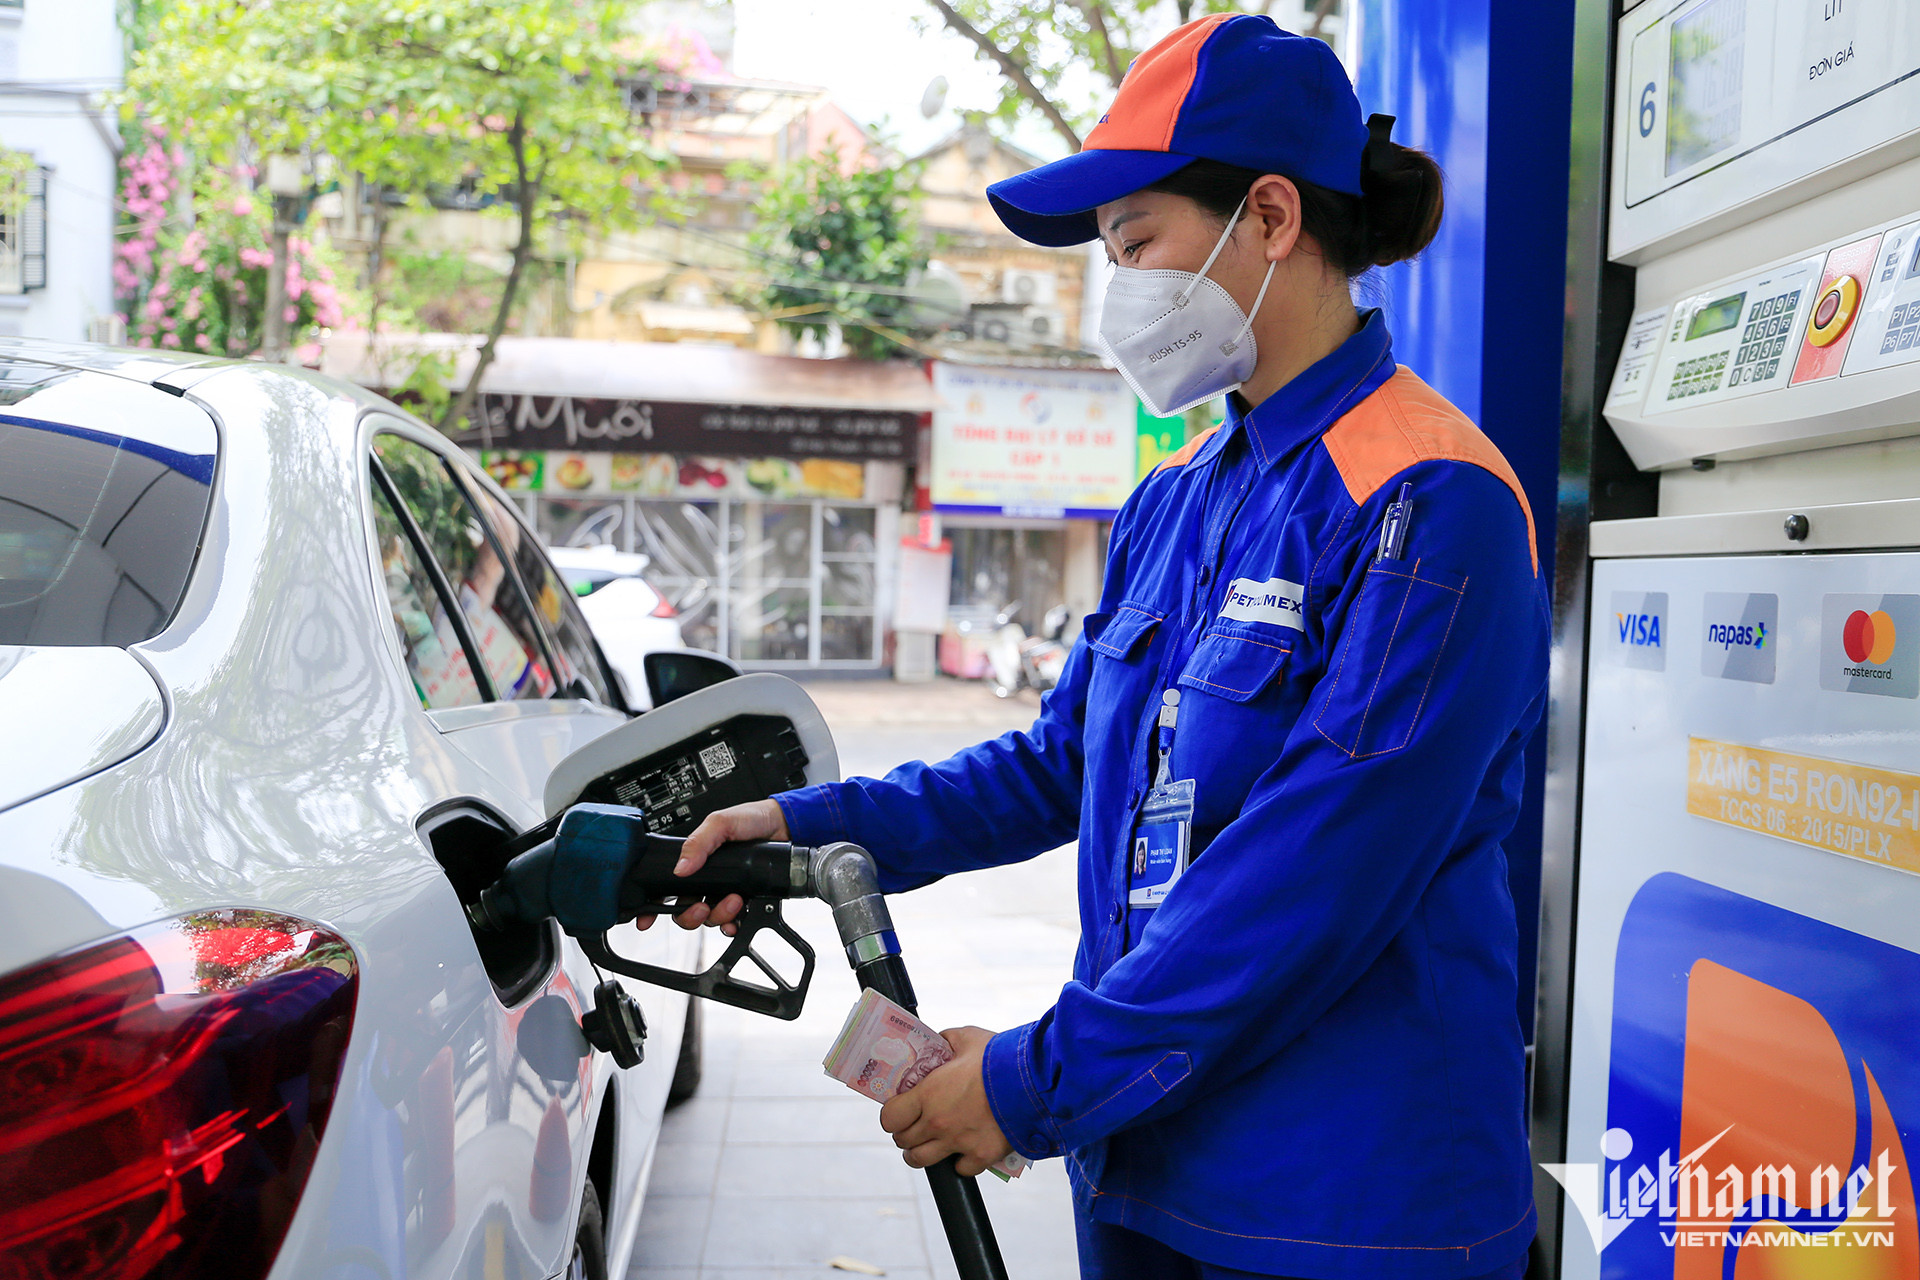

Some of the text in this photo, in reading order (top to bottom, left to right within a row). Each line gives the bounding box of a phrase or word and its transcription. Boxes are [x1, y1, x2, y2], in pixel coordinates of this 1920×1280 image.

[1809, 40, 1854, 80] ĐƠN GIÁ
[1639, 82, 1656, 138] 6
[1752, 305, 1761, 320] 7
[1763, 301, 1772, 316] 8
[1775, 297, 1784, 312] 9
[1891, 308, 1904, 324] P1
[1744, 319, 1791, 341] 4 5 6 F2
[1883, 335, 1897, 350] P6
[1899, 331, 1914, 346] P7
[1149, 329, 1203, 364] BUSH TS-95
[1739, 341, 1784, 364] 1 2 3 F3
[1732, 368, 1740, 385] 0
[1743, 367, 1752, 382] C
[1616, 612, 1661, 648] VISA
[1708, 623, 1753, 650] napas
[1697, 746, 1761, 796] XĂNG
[1768, 762, 1798, 804] E5
[661, 813, 673, 825] 95
[1718, 796, 1762, 828] TCCS
[1766, 807, 1786, 834] 06
[1801, 815, 1892, 861] 2015/PLX
